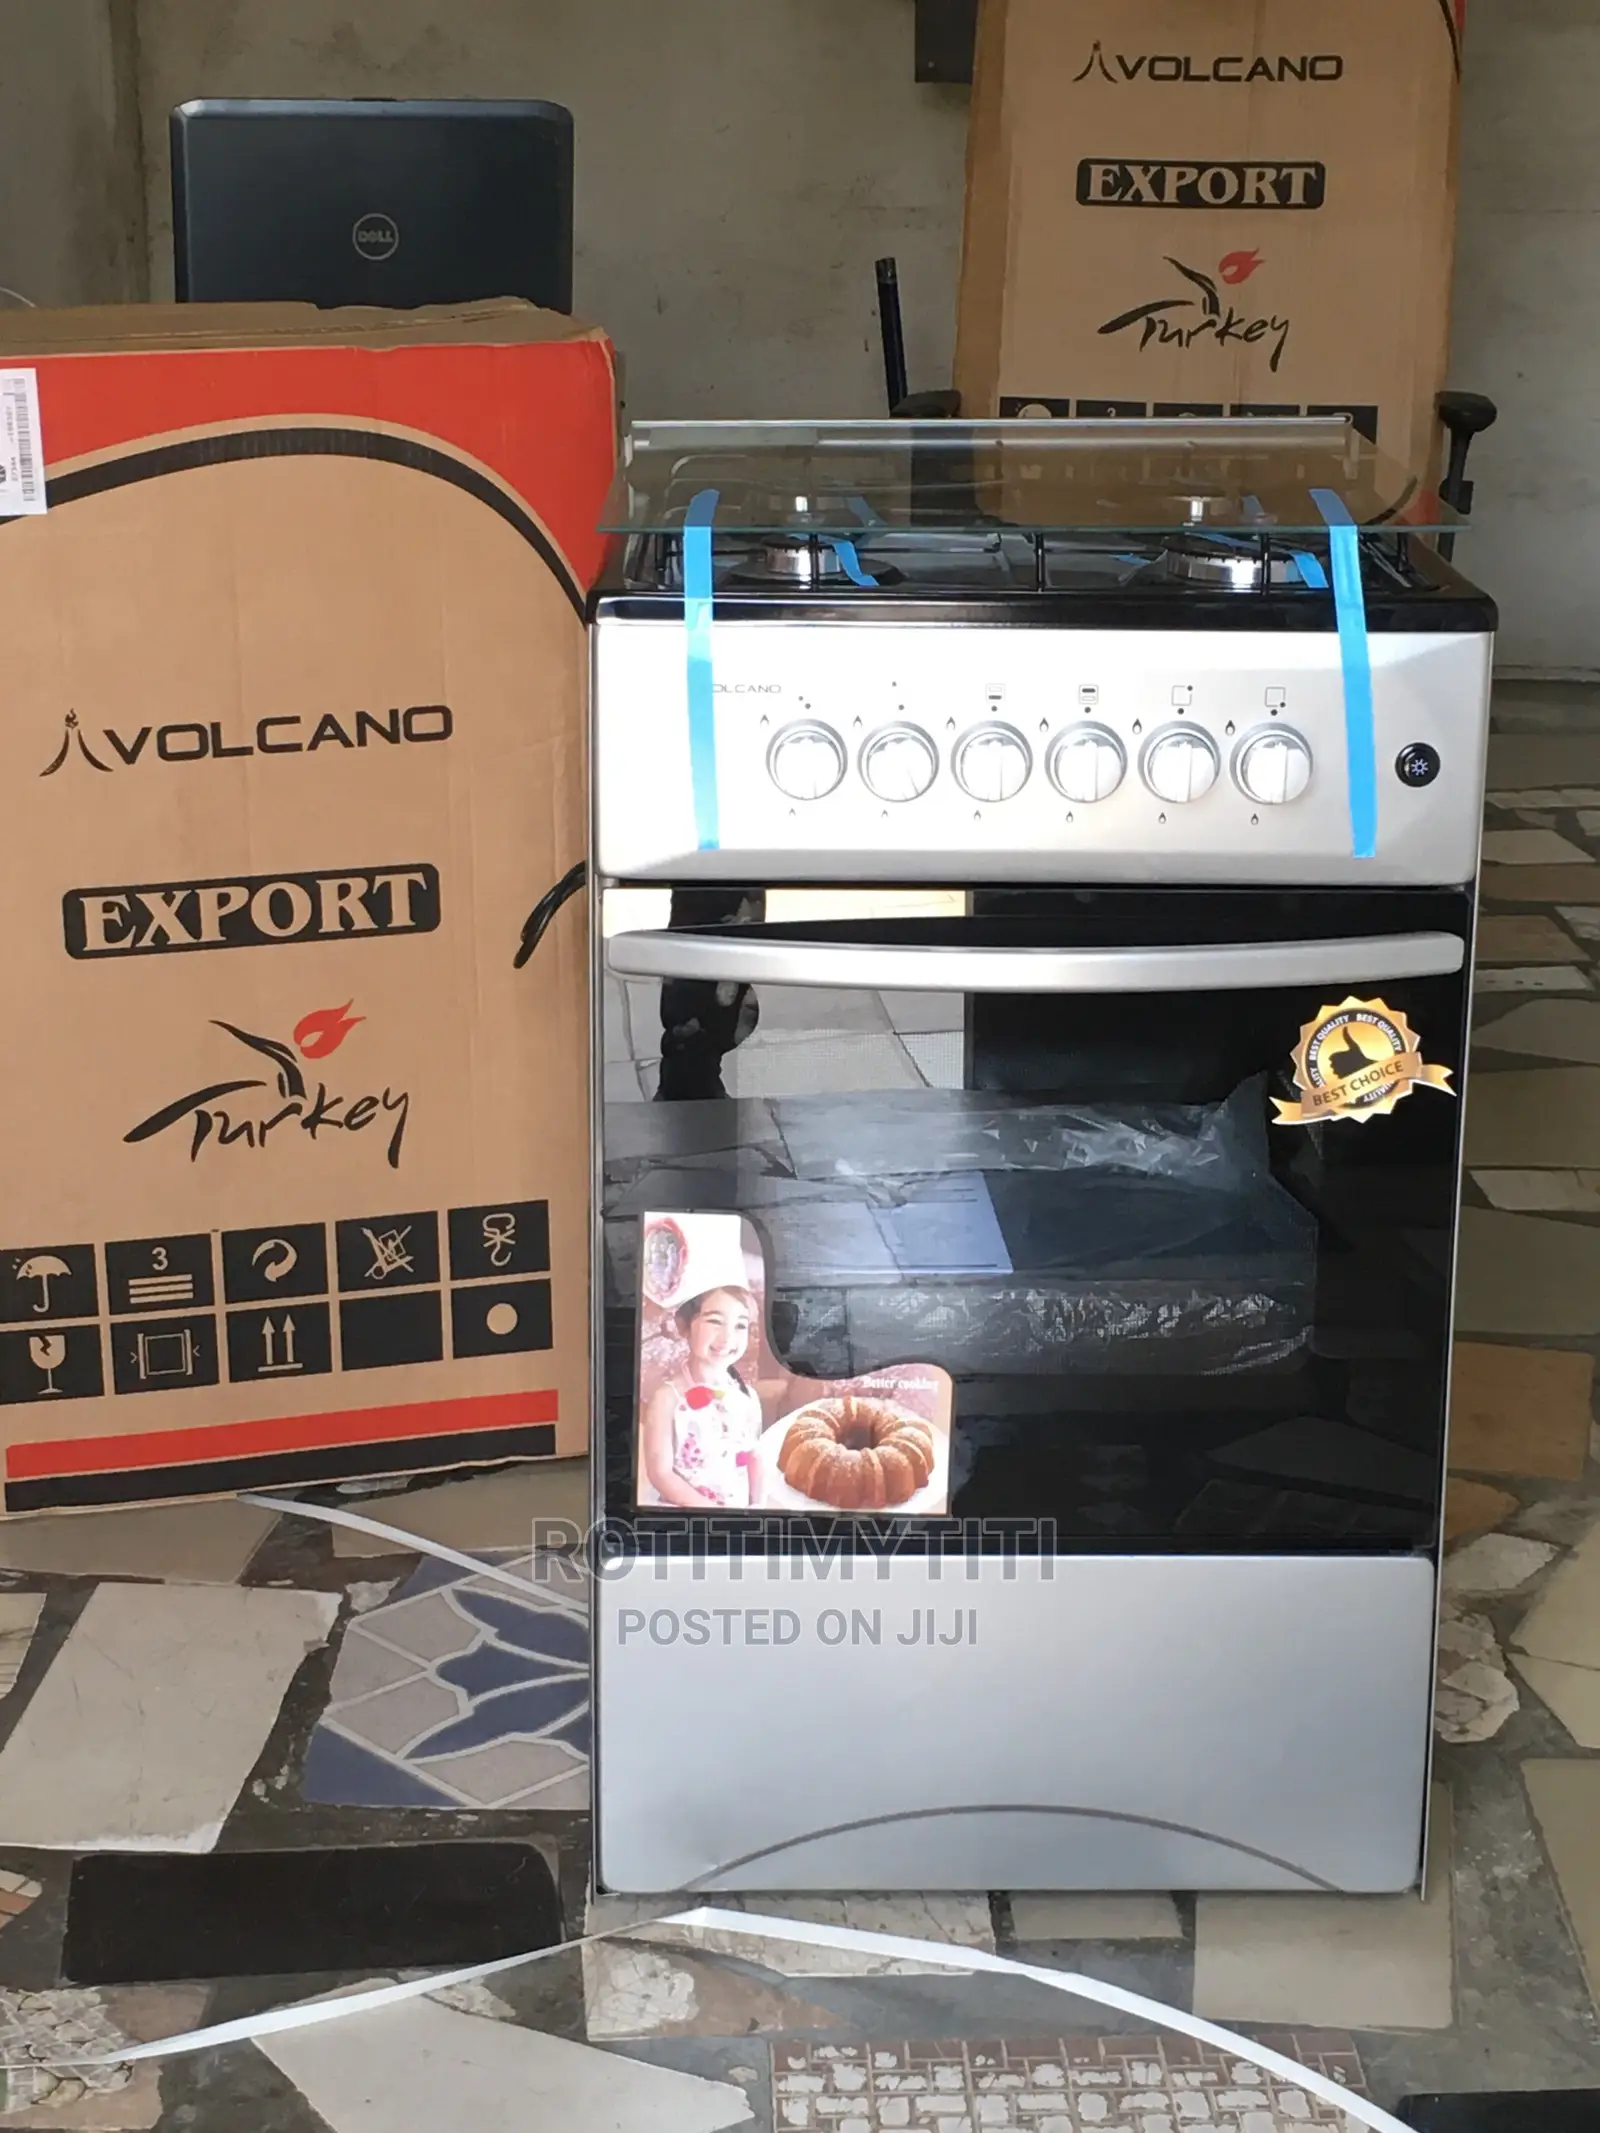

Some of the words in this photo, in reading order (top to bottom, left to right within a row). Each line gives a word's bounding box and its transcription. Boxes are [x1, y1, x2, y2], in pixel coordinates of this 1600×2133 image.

[1116, 55, 1343, 82] VOLCANO
[1088, 162, 1318, 207] EXPORT
[358, 230, 394, 243] DELL
[1097, 299, 1290, 372] Turkey
[713, 683, 782, 694] OLCANO
[103, 704, 454, 765] VOLCANO
[81, 871, 429, 952] EXPORT
[1309, 1040, 1319, 1060] BEST
[1316, 1015, 1349, 1040] QUALITY
[1356, 1012, 1379, 1024] BEST
[1378, 1020, 1402, 1051] QUALITY
[1312, 1085, 1347, 1106] BEST
[1350, 1061, 1403, 1091] CHOICE
[123, 1080, 410, 1168] Turkey
[152, 1247, 169, 1271] 3
